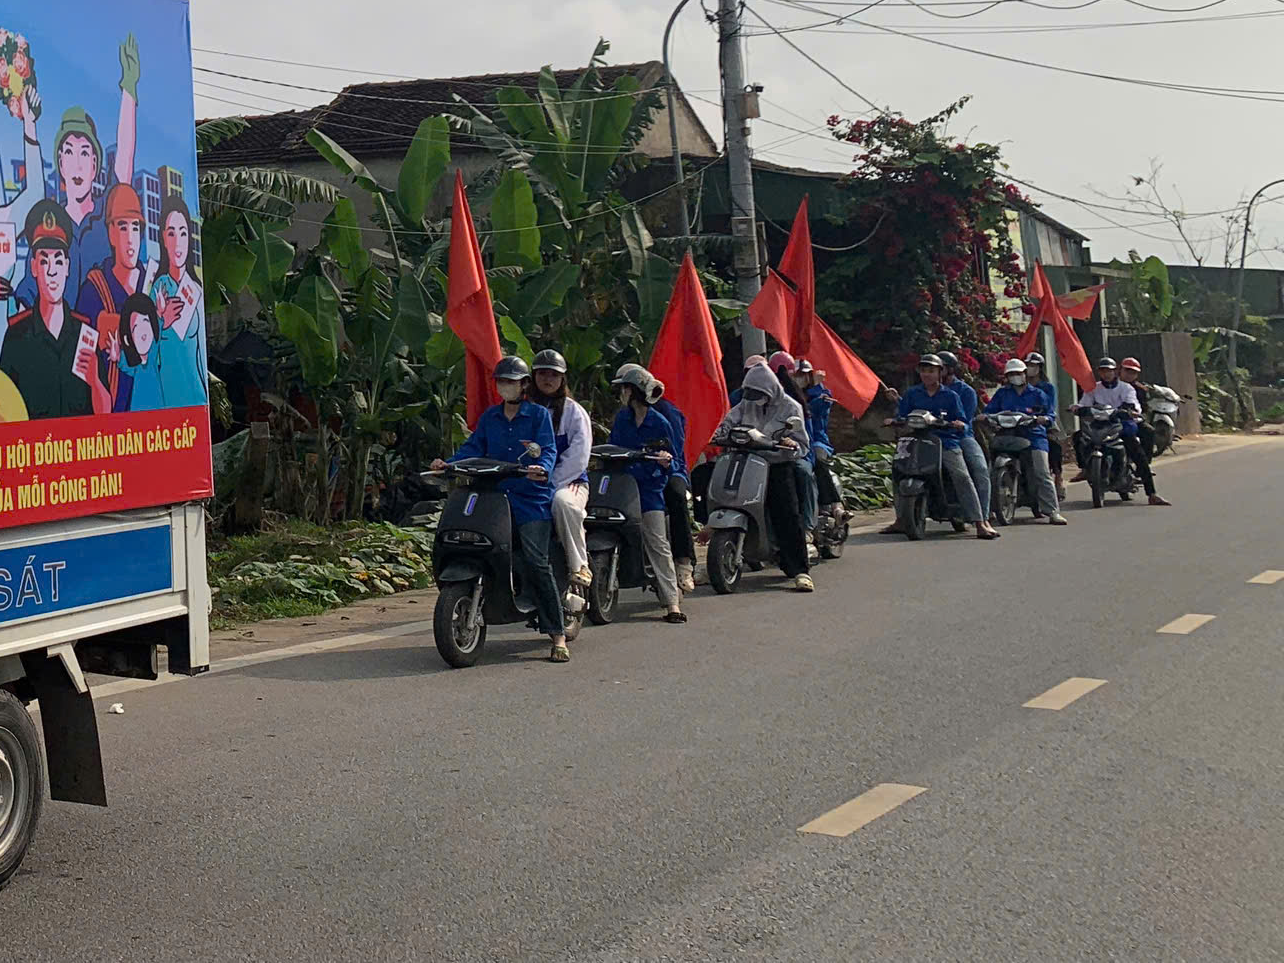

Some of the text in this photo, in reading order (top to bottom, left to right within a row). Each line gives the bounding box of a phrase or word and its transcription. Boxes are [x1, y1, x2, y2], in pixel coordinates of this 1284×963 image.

[7, 439, 31, 473] HỘI
[34, 433, 73, 467] ĐỒNG
[77, 432, 113, 462] NHÂN
[117, 428, 143, 456] DÂN
[146, 425, 170, 452] CÁC
[174, 419, 197, 449] CẤP
[17, 474, 46, 509] MỖI
[49, 475, 87, 504] CÔNG
[90, 470, 122, 499] DÂN!
